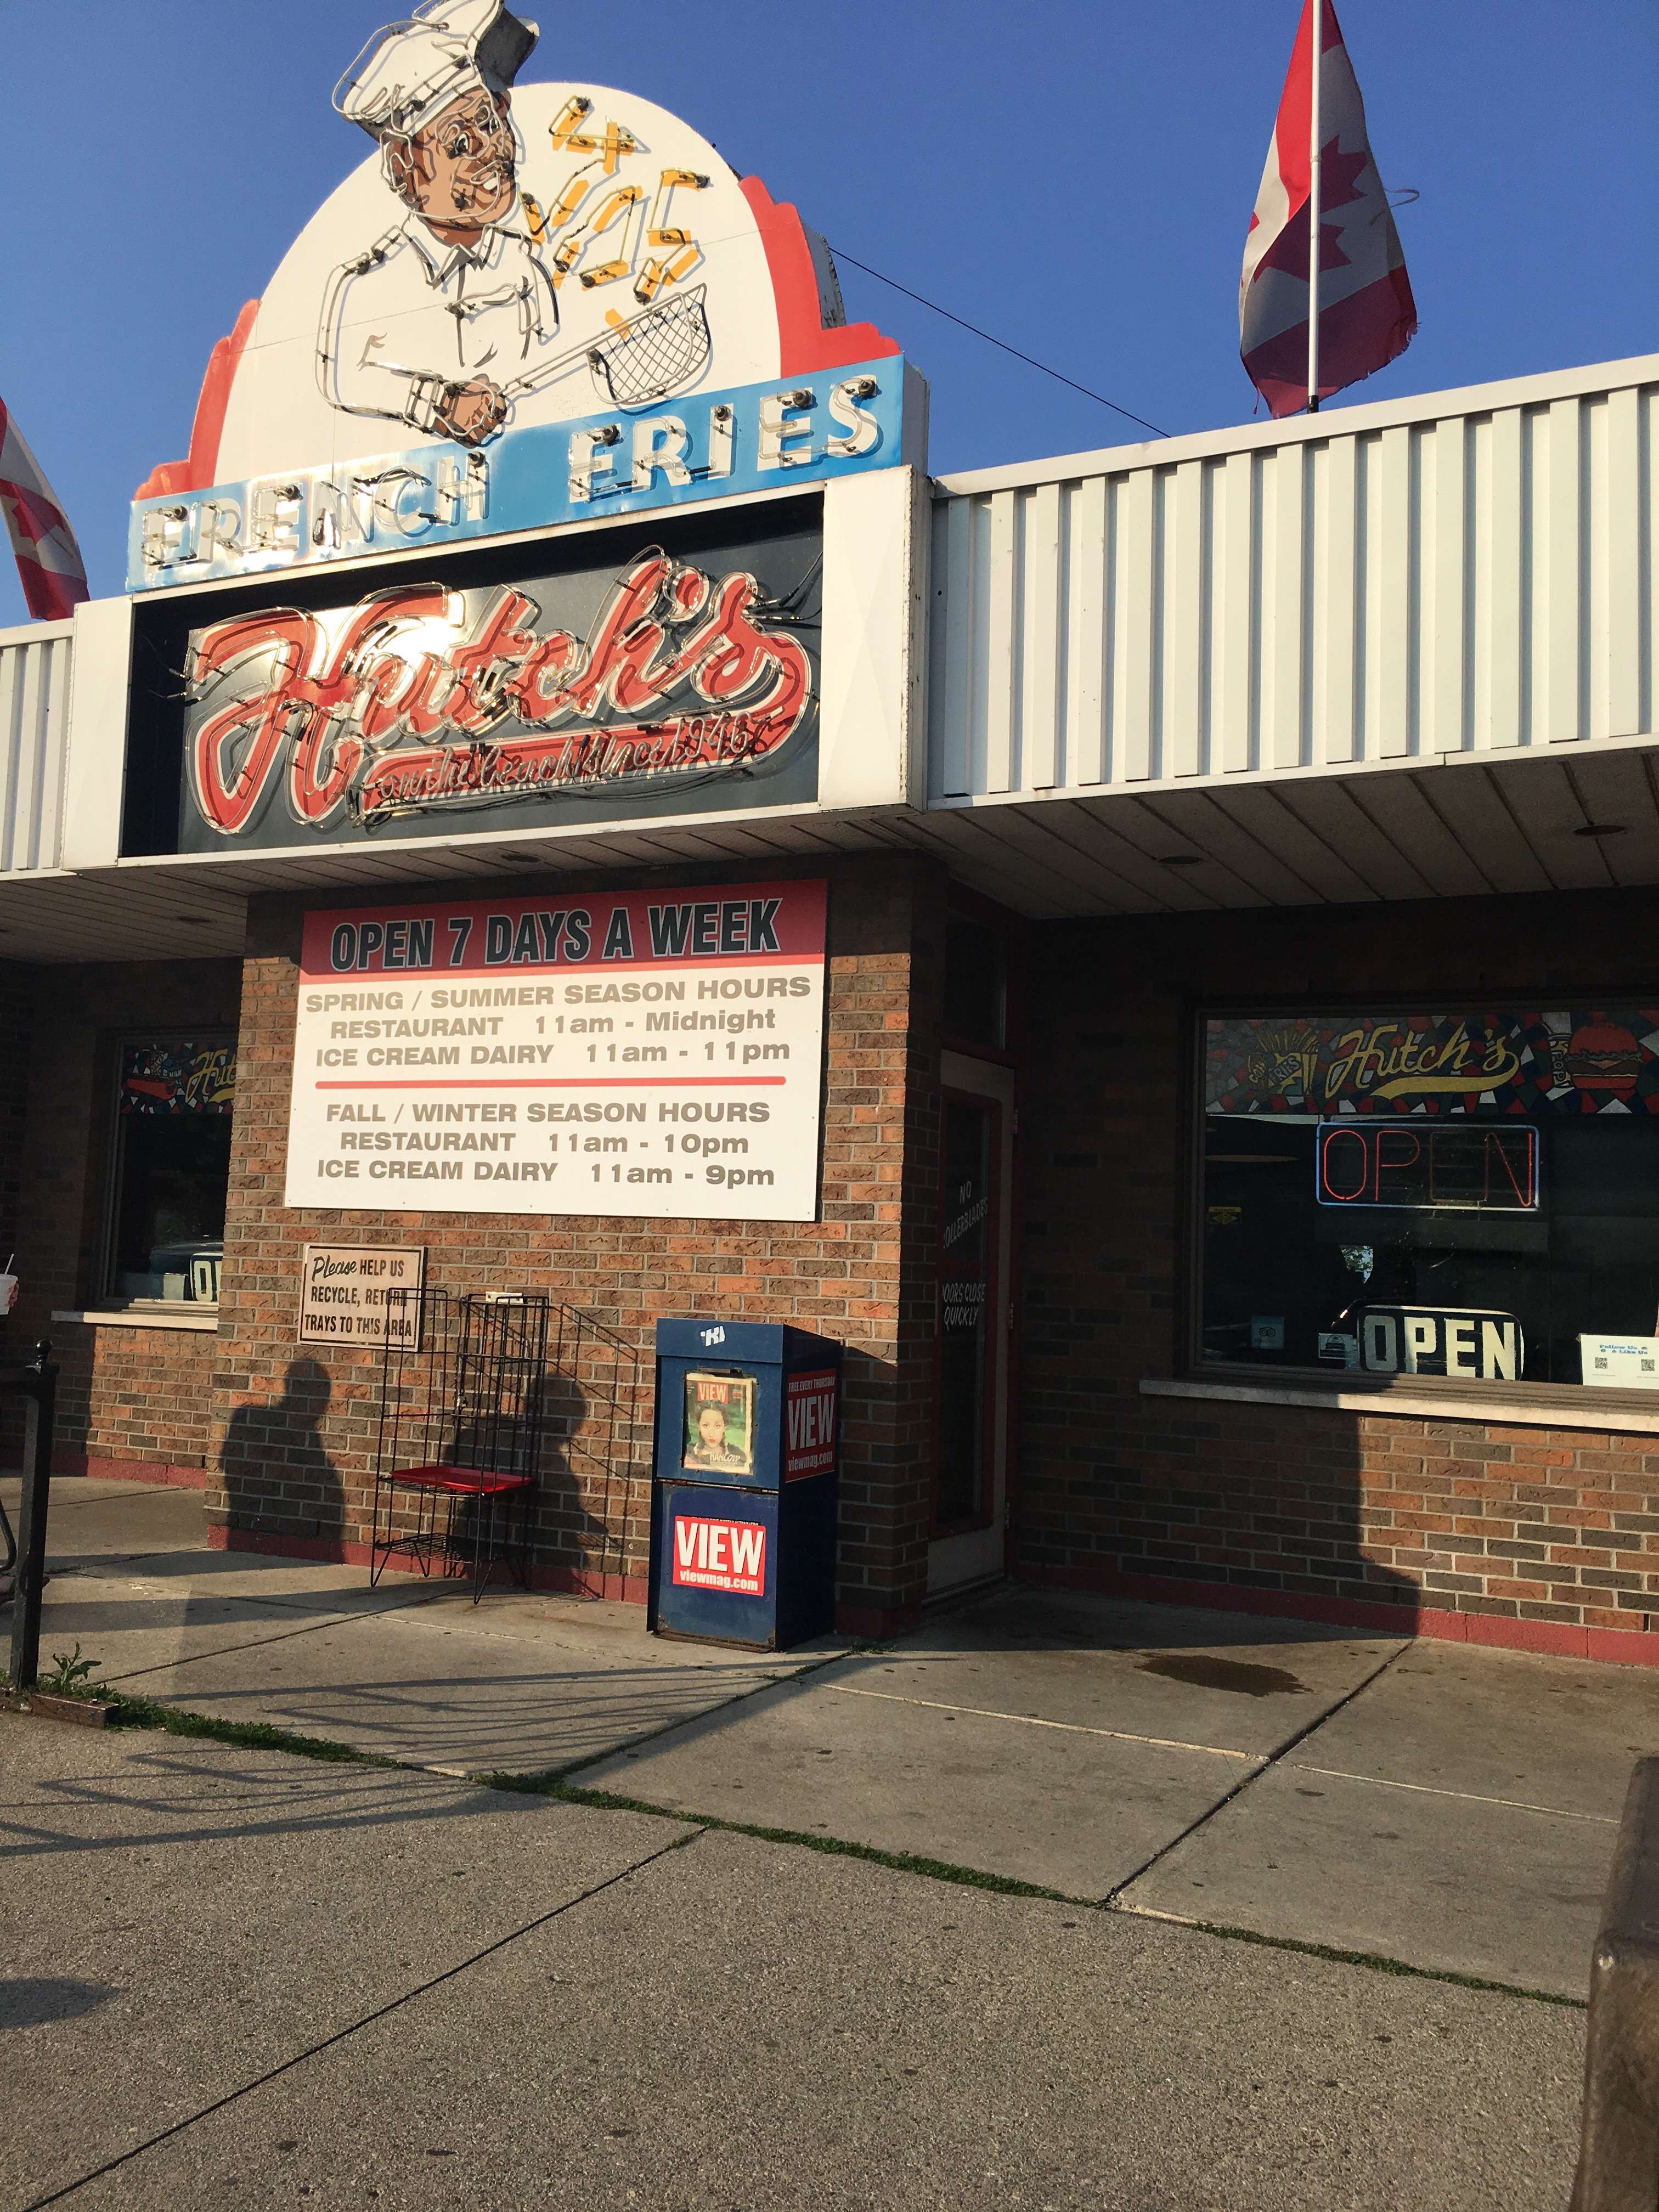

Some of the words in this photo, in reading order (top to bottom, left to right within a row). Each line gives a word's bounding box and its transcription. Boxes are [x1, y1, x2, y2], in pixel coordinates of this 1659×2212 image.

[141, 450, 489, 566] FRENCH
[568, 374, 880, 503] FRIES
[185, 545, 813, 834] Hutch's
[330, 918, 435, 972] OPEN
[448, 916, 473, 966] 7
[484, 909, 592, 965] DAYS
[602, 907, 634, 959] A
[647, 898, 783, 957] WEEK
[306, 991, 404, 1012] SPRING
[411, 990, 422, 1011] /
[431, 986, 554, 1009] SUMMER
[564, 981, 685, 1004] SEASON
[697, 977, 811, 1000] HOURS
[331, 1017, 503, 1039] RESTAURANT
[536, 1015, 613, 1034] 11am
[645, 1008, 775, 1034] Midnight
[316, 1048, 358, 1066] ICE
[366, 1046, 460, 1065] CREAM
[471, 1044, 554, 1064] DAIRY
[587, 1043, 667, 1062] 11am
[704, 1041, 790, 1064] 11pm
[1324, 1021, 1520, 1100] Hutch's
[326, 1104, 386, 1122] FALL
[393, 1103, 404, 1124] /
[411, 1103, 517, 1122] WINTER
[527, 1103, 646, 1122] SEASON
[658, 1102, 770, 1122] HOURS
[341, 1132, 516, 1151] RESTAURANT
[549, 1133, 628, 1152] 11am
[665, 1133, 748, 1158] 10pm
[318, 1159, 359, 1177] ICE
[369, 1160, 463, 1180] CREAM
[474, 1161, 558, 1181] DAIRY
[591, 1163, 673, 1183] 11am
[706, 1165, 774, 1189] 9pm
[1323, 1129, 1533, 1207] OPEN
[959, 1181, 972, 1205] NO
[943, 1197, 988, 1250] OLLERBLADES
[312, 1255, 357, 1282] Please
[359, 1259, 387, 1276] HELP
[390, 1260, 404, 1277] US
[311, 1286, 360, 1308] RECYCLE,
[365, 1289, 408, 1306] RETURN
[942, 1283, 963, 1303] OORS
[304, 1314, 337, 1333] TRAYS
[340, 1316, 353, 1333] TO
[357, 1317, 381, 1335] THIS
[383, 1319, 412, 1336] AREA
[944, 1306, 979, 1331] QUICKLY
[1363, 1315, 1516, 1380] OPEN
[698, 1383, 726, 1403] VIEW
[788, 1393, 834, 1451] VIEW
[788, 1451, 833, 1471] viewmag.com
[676, 1520, 764, 1576] VIEW
[680, 1570, 758, 1591] viewmag.com
